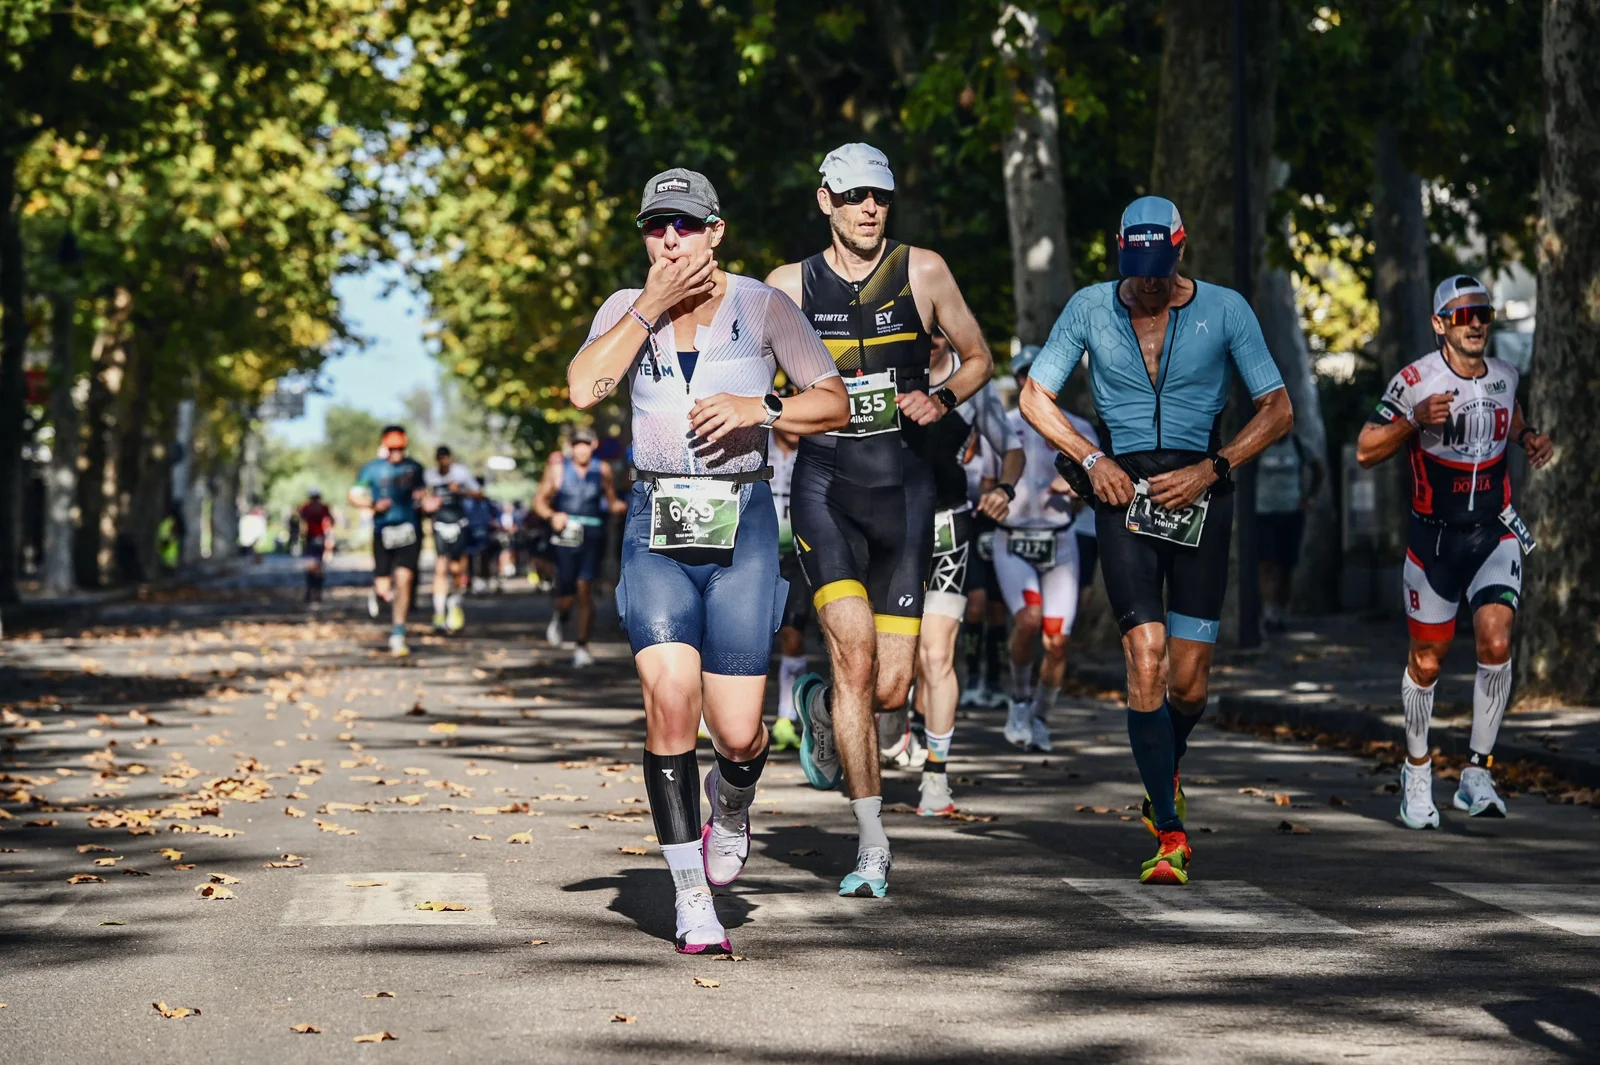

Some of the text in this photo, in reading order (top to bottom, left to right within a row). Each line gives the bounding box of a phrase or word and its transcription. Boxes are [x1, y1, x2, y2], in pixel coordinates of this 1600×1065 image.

[1128, 230, 1165, 242] IRONMAN
[814, 313, 849, 322] TRIMTEX
[875, 311, 893, 326] EY
[669, 501, 715, 523] 649
[1143, 498, 1195, 526] 1442
[1154, 518, 1179, 530] Heinz
